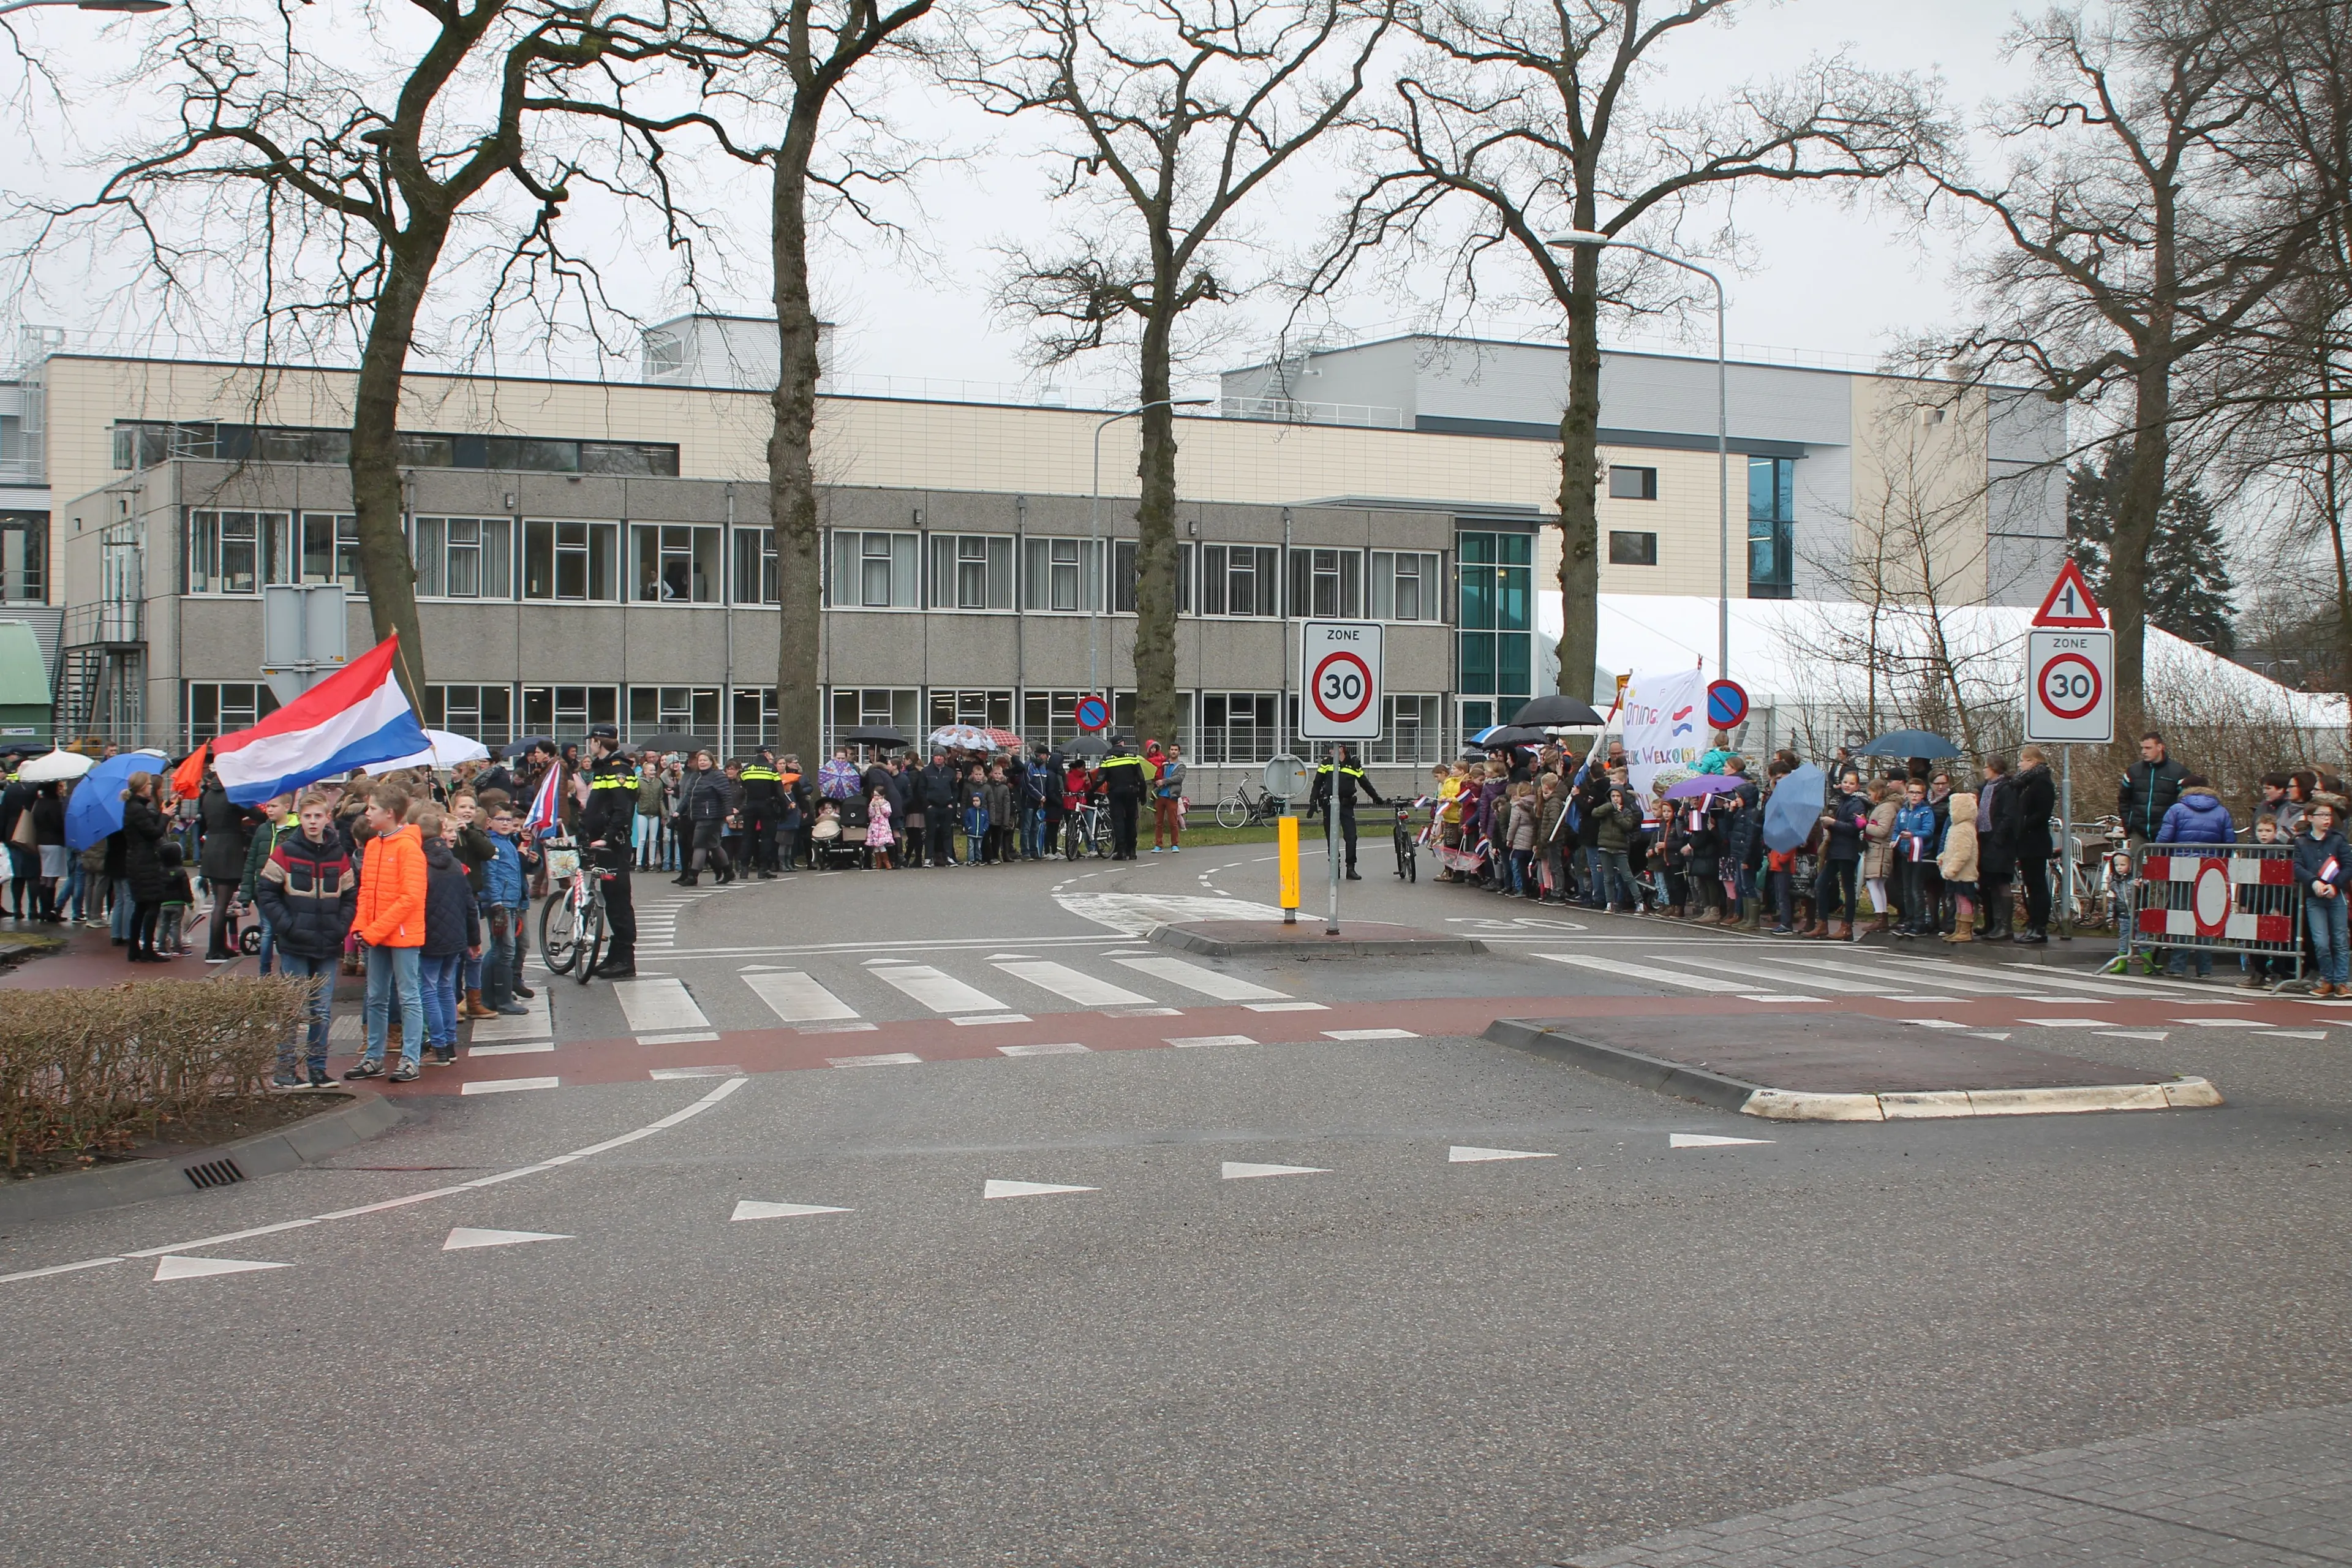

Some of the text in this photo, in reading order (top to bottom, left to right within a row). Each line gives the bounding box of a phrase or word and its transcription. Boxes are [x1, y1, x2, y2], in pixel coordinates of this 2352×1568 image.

[1327, 630, 1360, 641] ZONE
[2052, 638, 2088, 649] ZONE
[1324, 674, 1361, 700] 30
[2050, 674, 2090, 698] 30
